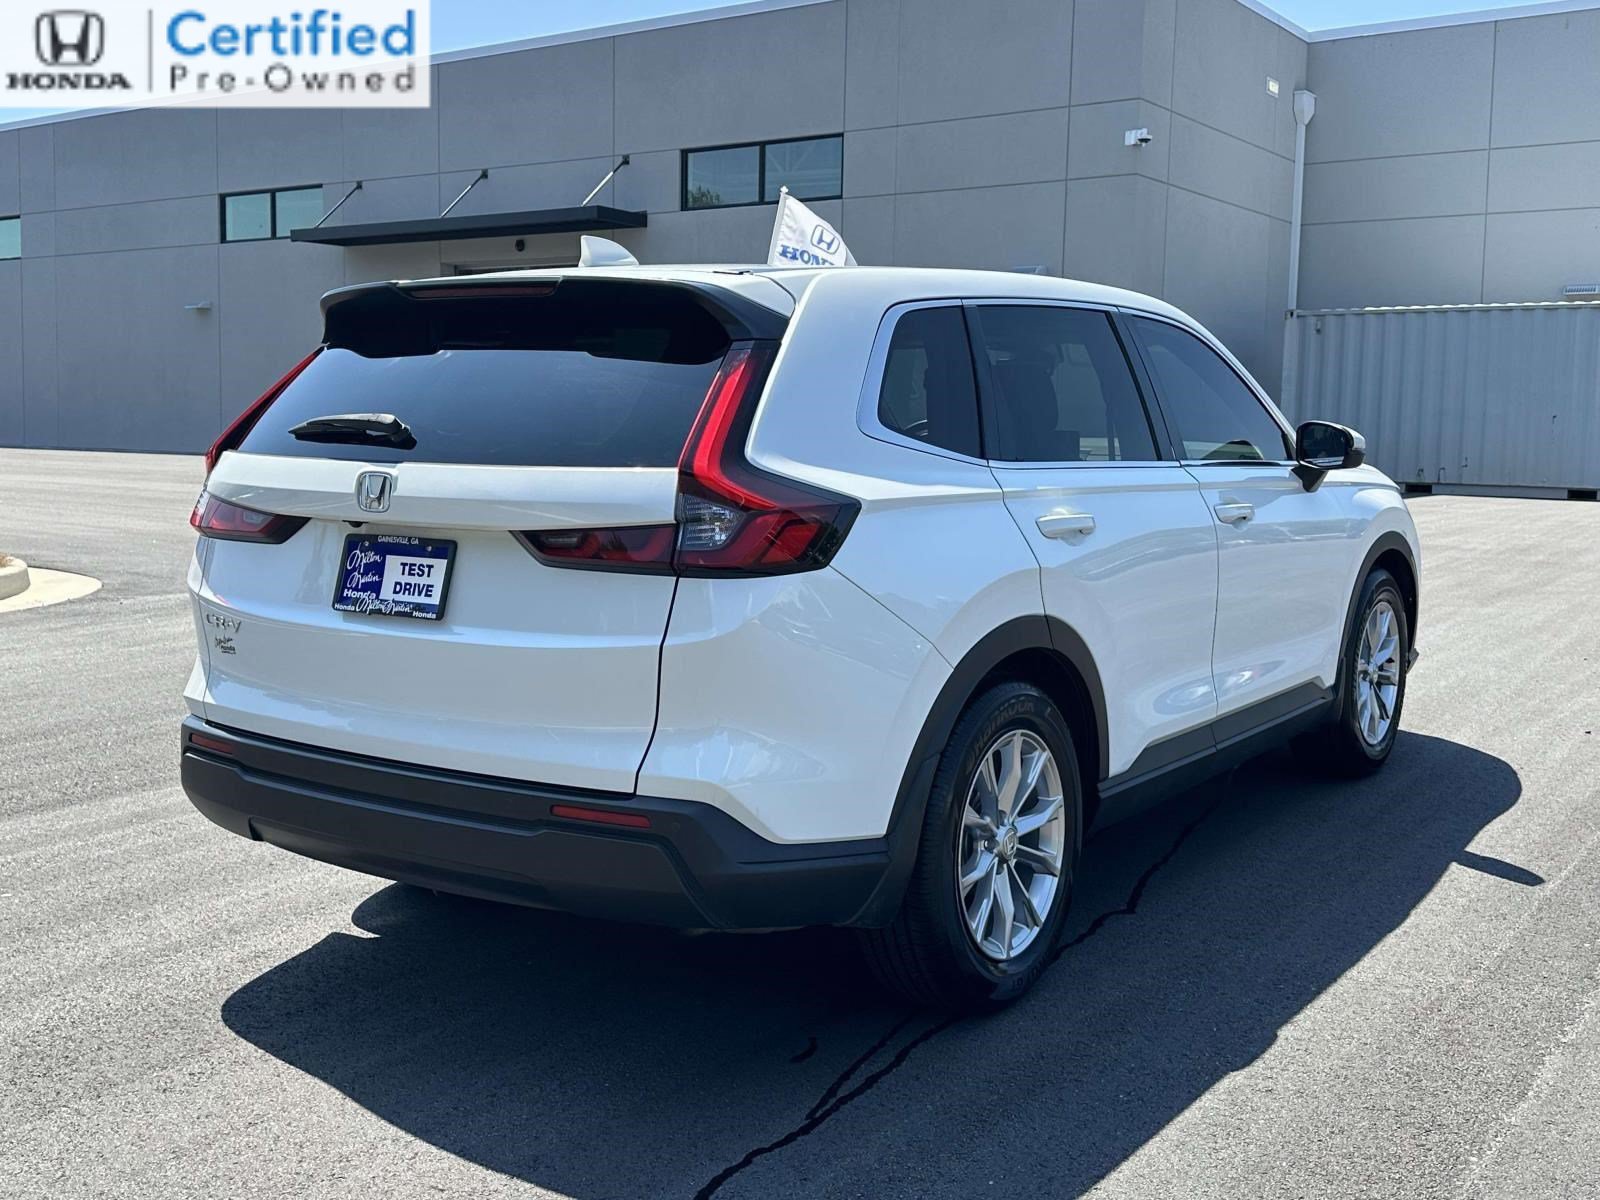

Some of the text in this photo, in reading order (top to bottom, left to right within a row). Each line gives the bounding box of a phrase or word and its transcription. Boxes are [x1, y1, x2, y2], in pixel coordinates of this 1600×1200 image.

[411, 537, 419, 545] GA
[400, 562, 434, 577] TEST
[343, 588, 376, 599] Honda
[392, 581, 434, 598] DRIVE
[334, 603, 355, 611] Honda
[412, 610, 437, 619] Honda
